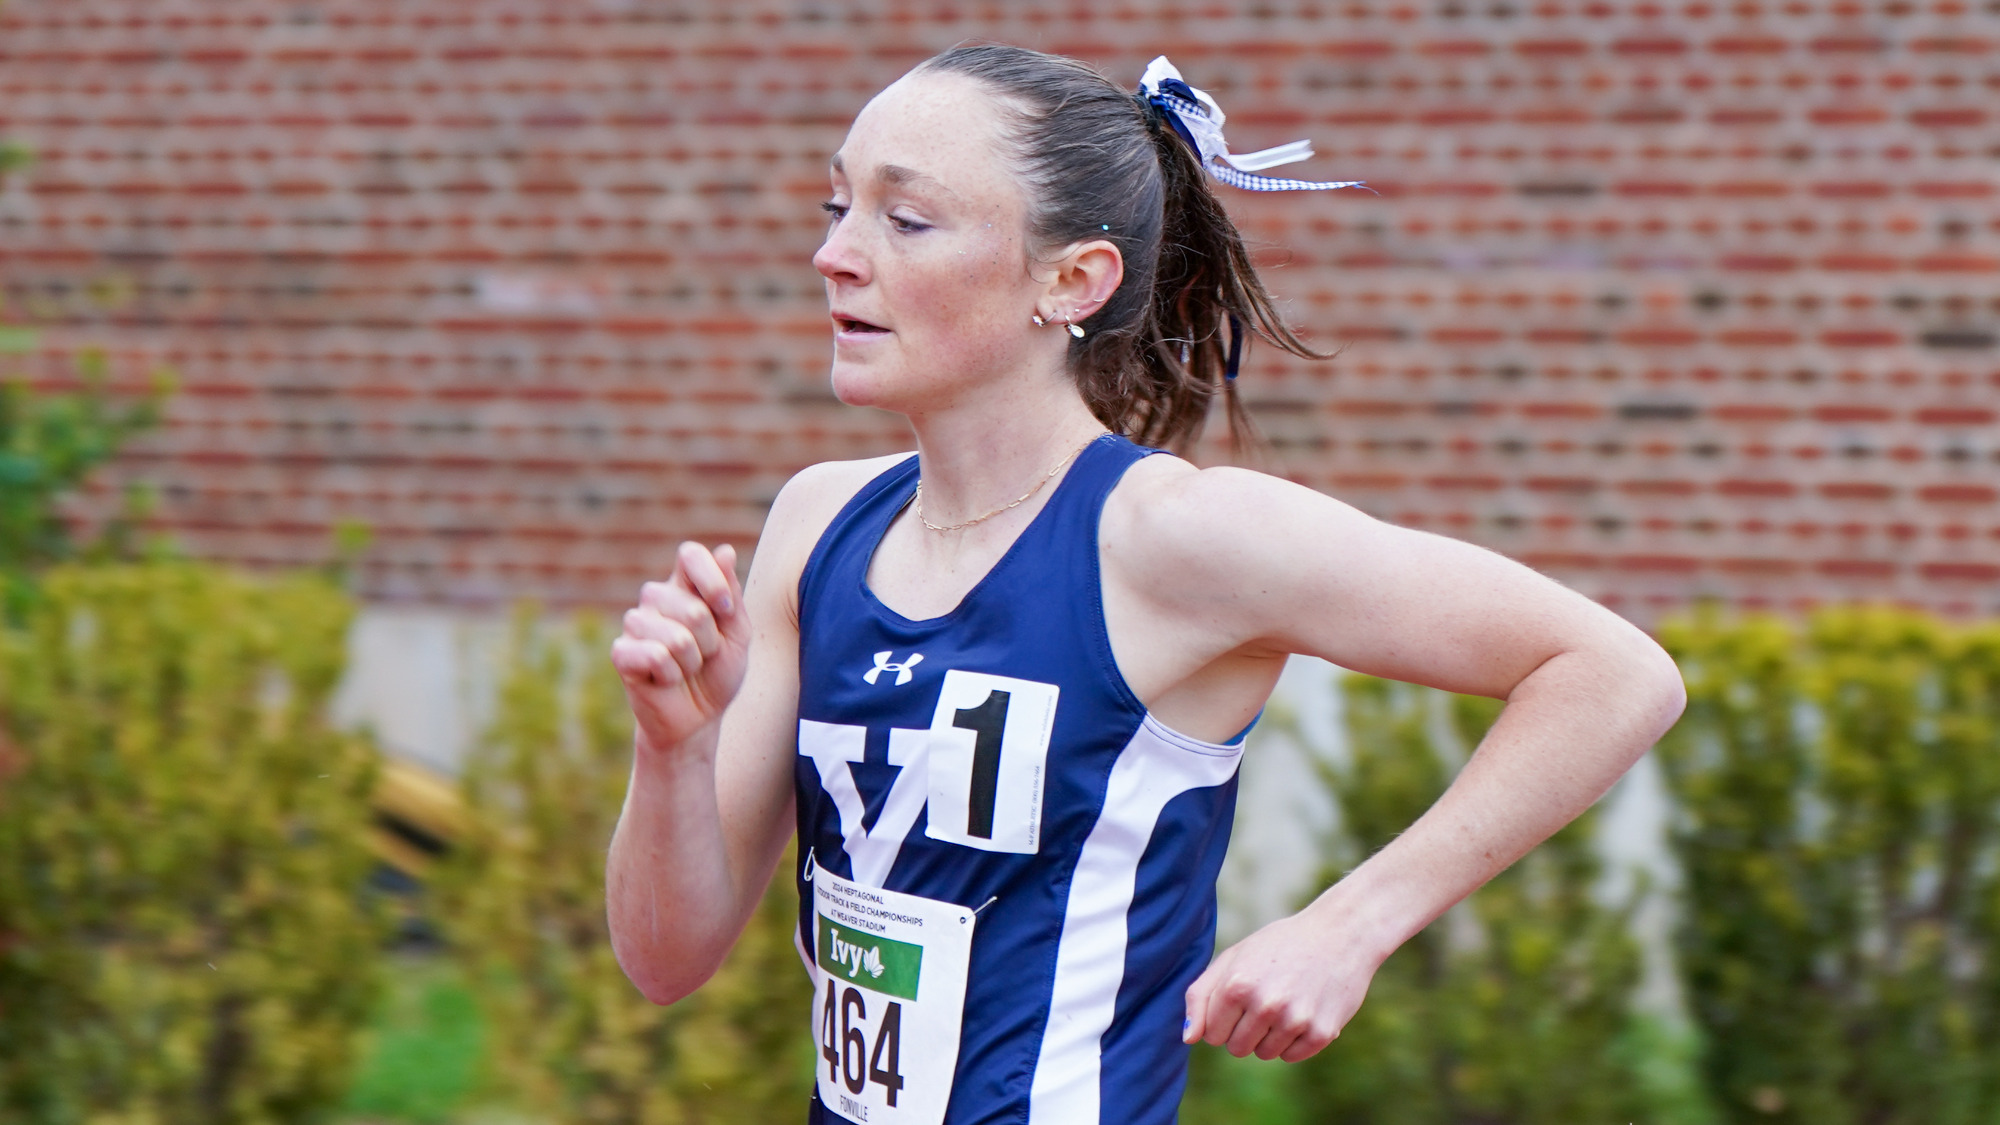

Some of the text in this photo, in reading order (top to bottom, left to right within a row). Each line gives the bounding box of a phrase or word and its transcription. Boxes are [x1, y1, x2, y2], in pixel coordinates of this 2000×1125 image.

[952, 689, 1011, 840] 1
[831, 894, 845, 907] TRACK
[850, 902, 866, 914] FIELD
[866, 907, 923, 927] CHAMPIONSHIPS
[844, 886, 884, 905] HEPTAGONAL
[831, 908, 886, 933] AT WEAVER STADIUM
[830, 928, 864, 978] Ivy
[823, 978, 904, 1108] 464
[840, 1095, 868, 1122] FONVILLE
